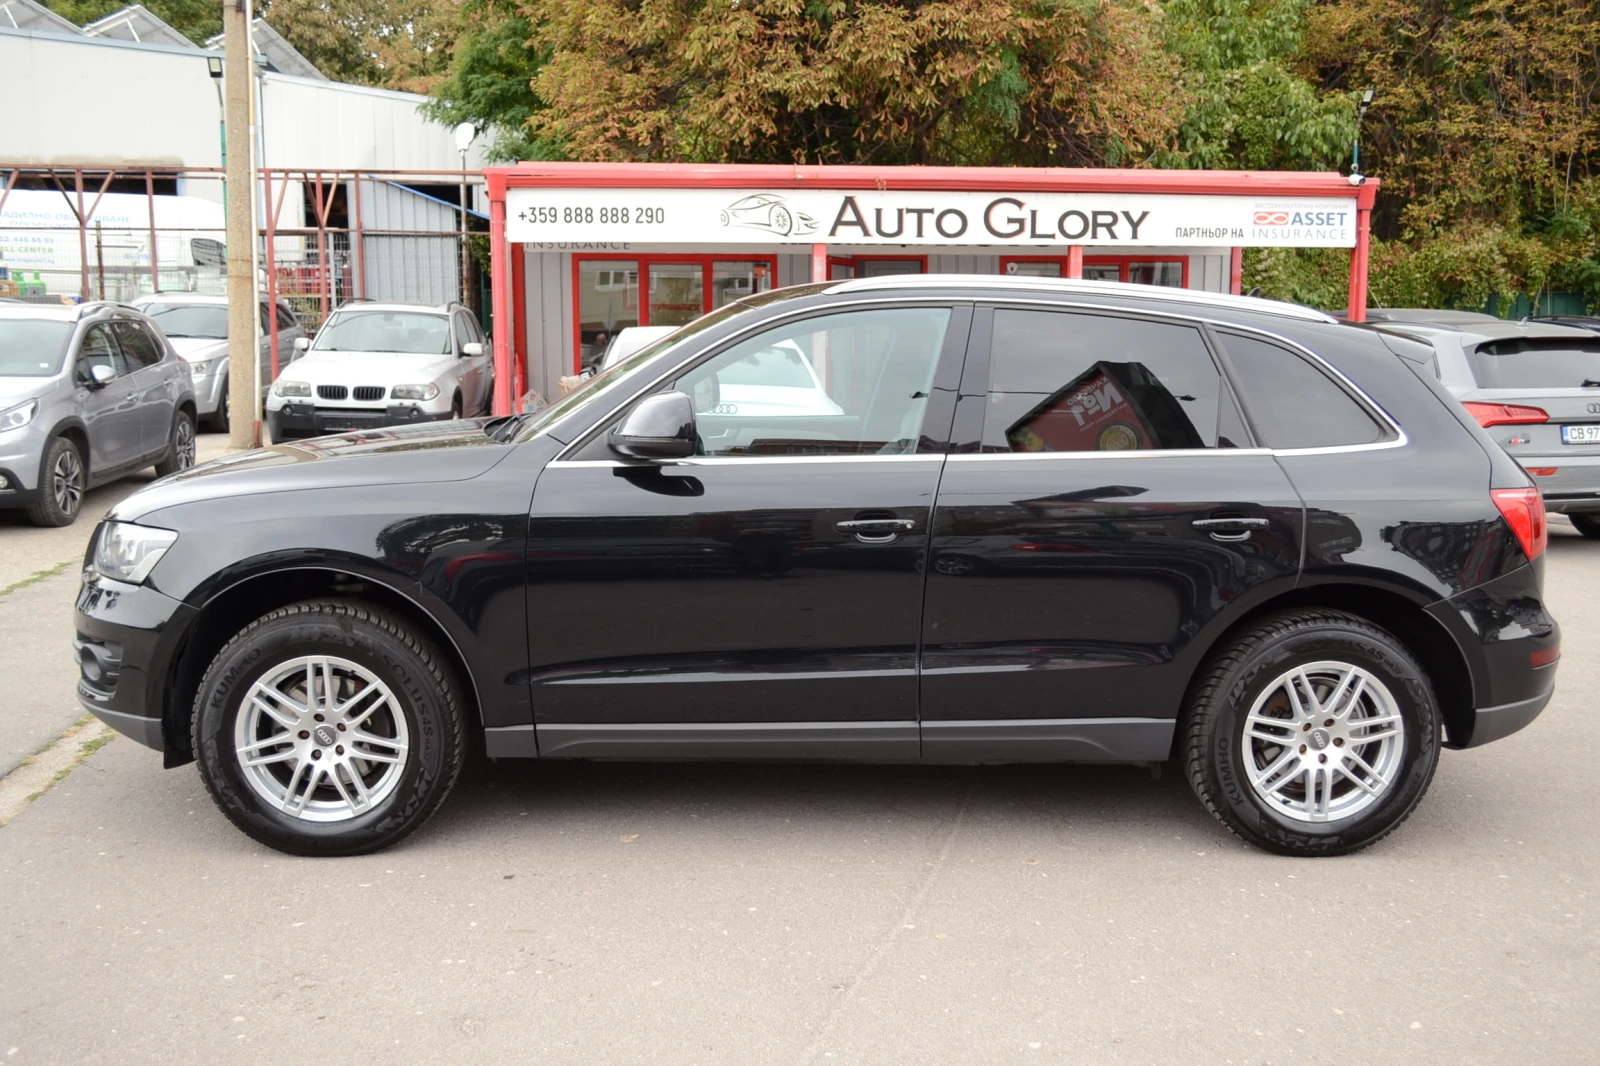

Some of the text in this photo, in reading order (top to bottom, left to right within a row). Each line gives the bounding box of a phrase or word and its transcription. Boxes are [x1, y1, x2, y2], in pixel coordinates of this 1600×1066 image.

[518, 206, 665, 224] +359 888 888 290
[1291, 212, 1348, 226] ASSET
[1175, 227, 1244, 238] ПАРТНЬОР НА
[1252, 228, 1347, 240] INSURANCE
[18, 246, 54, 254] CENTER
[1218, 737, 1245, 807] KUMHO
